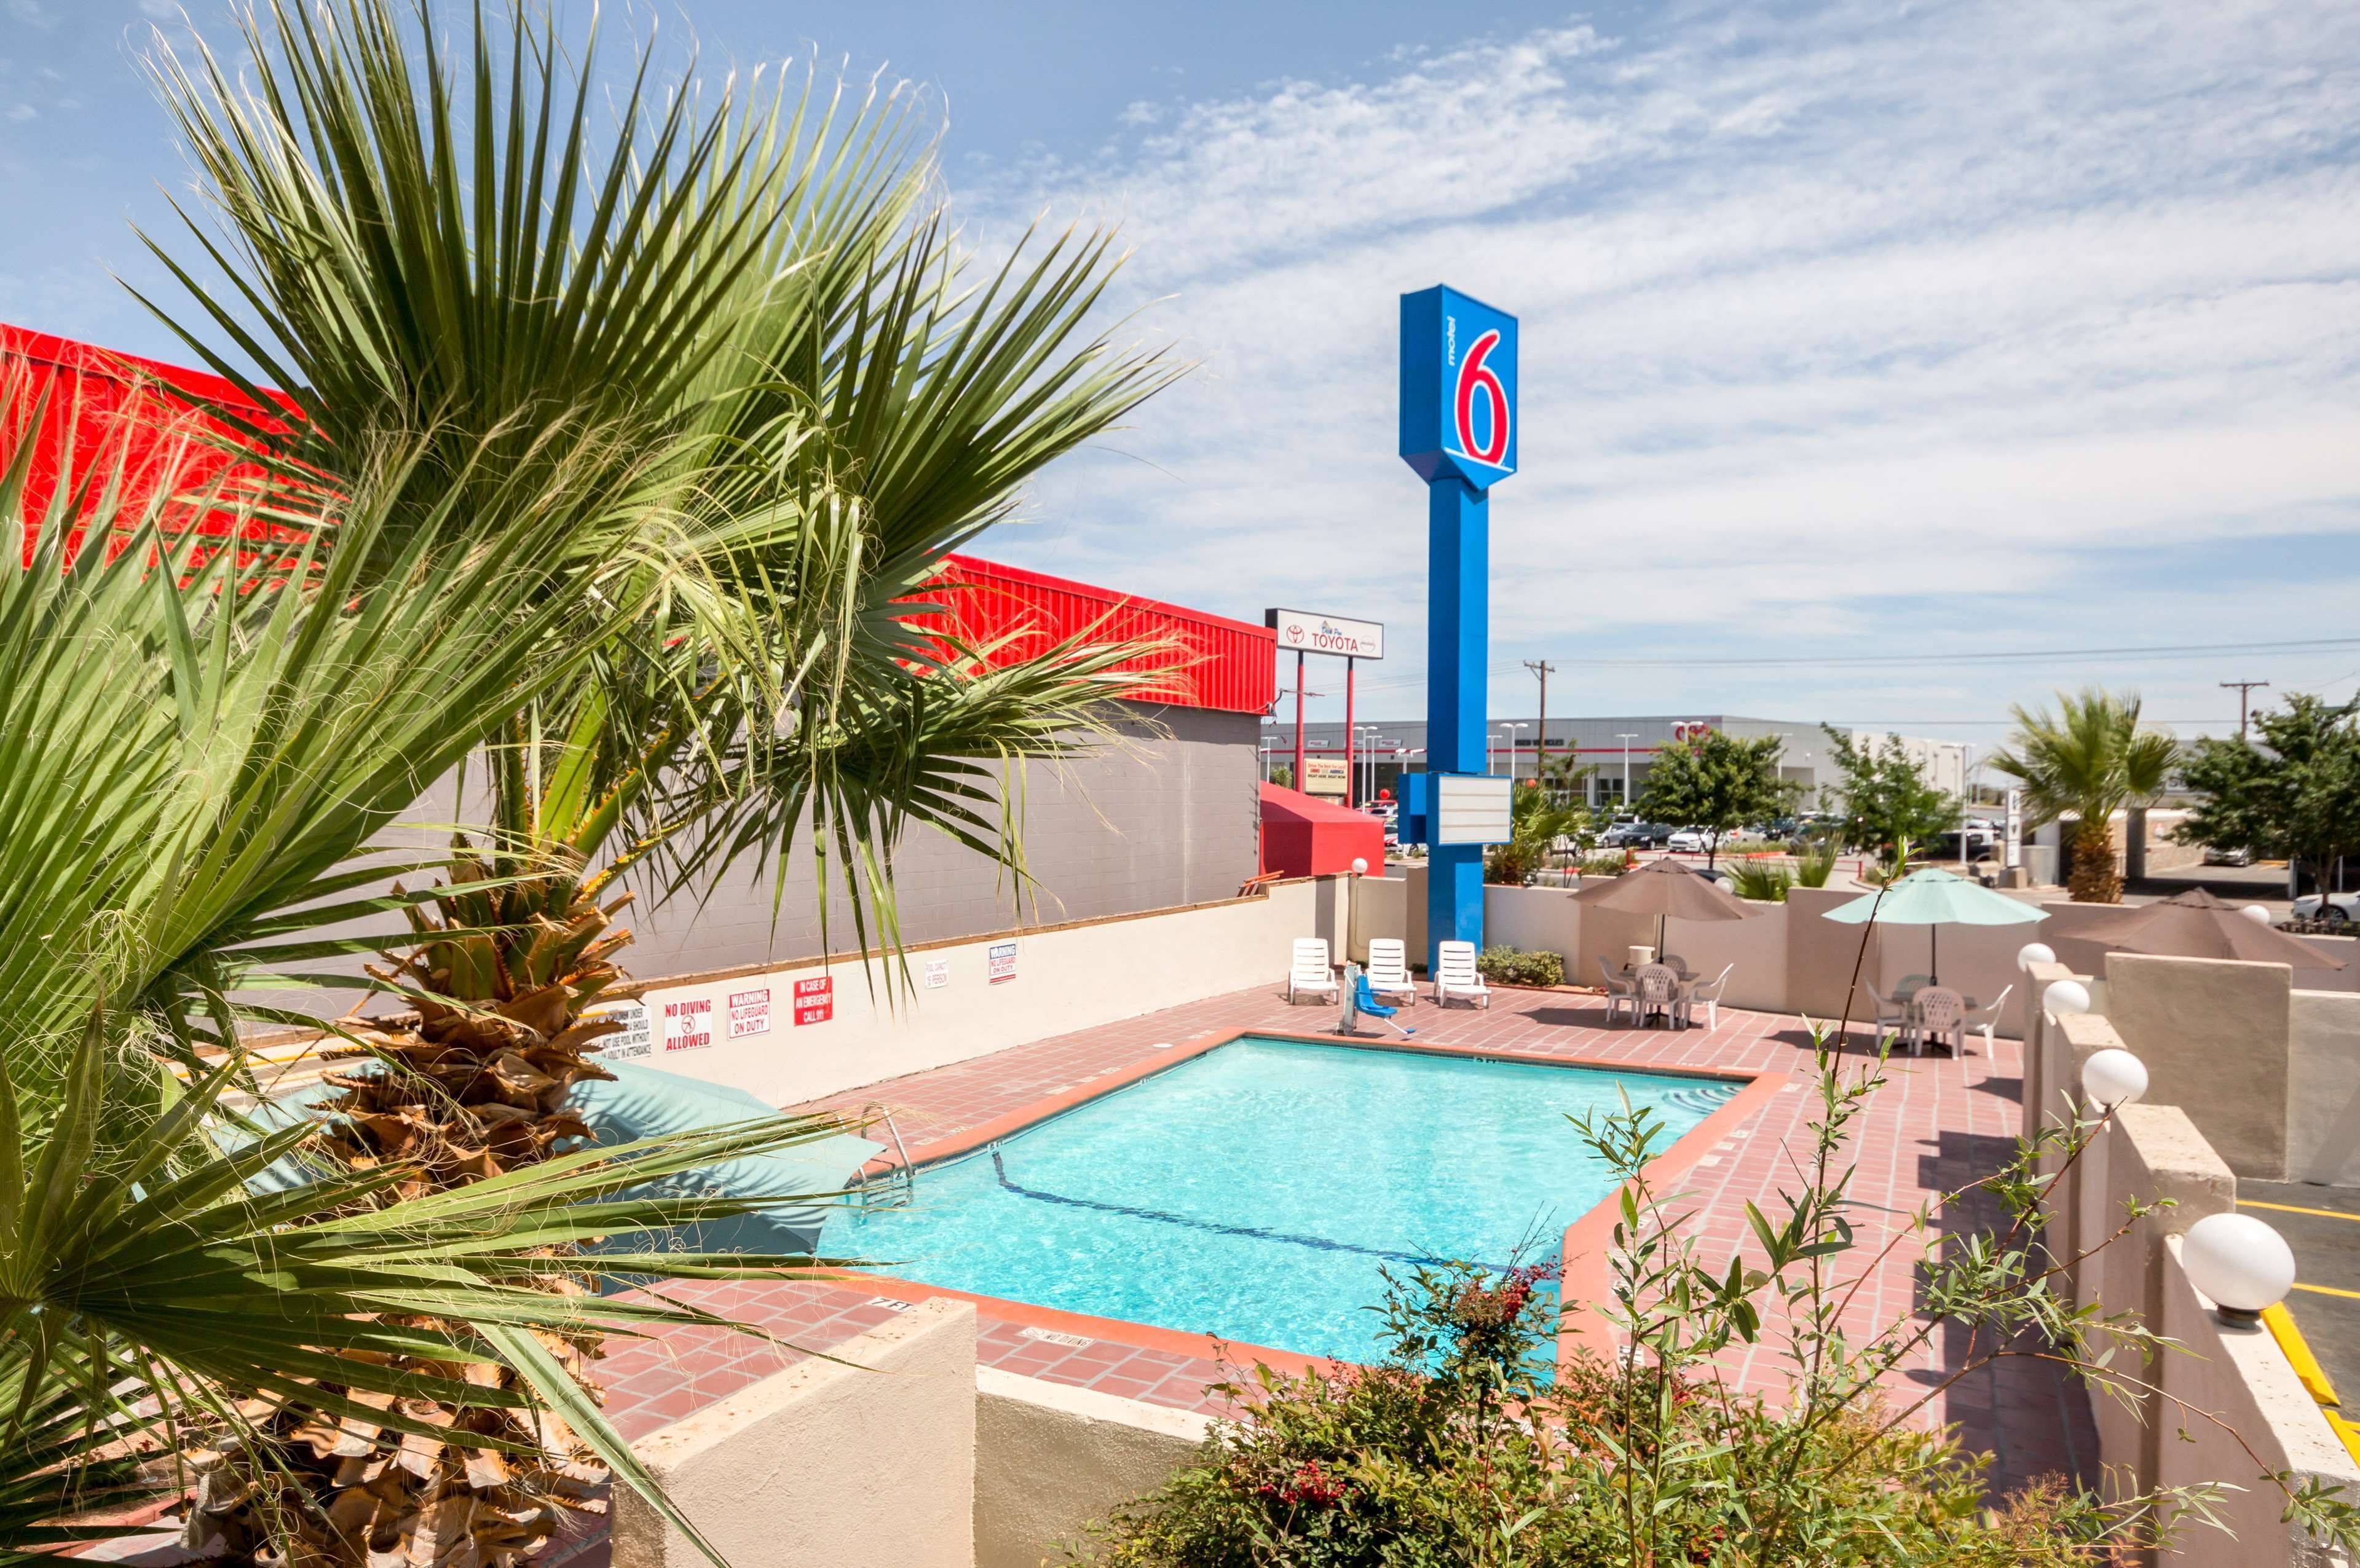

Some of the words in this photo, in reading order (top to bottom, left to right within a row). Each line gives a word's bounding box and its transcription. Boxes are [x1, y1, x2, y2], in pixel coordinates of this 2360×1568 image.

[1446, 315, 1456, 366] motel
[1454, 328, 1510, 467] 6
[1312, 633, 1358, 652] TOYOTA
[990, 945, 1015, 959] WARNING
[806, 980, 819, 991] CASE
[732, 990, 768, 1007] WARNING
[795, 996, 803, 1009] AN
[803, 993, 831, 1007] EMERGENCY
[665, 1003, 677, 1017] NO
[681, 999, 711, 1015] DIVING
[732, 1009, 739, 1021] NO
[740, 1004, 768, 1020] LIFEGUARD
[803, 1011, 816, 1022] CALL
[633, 1019, 649, 1031] SHOULD
[735, 1023, 744, 1034] ON
[747, 1018, 765, 1032] DUTY
[621, 1034, 631, 1046] POOL
[632, 1031, 650, 1044] WITHOUT
[666, 1032, 709, 1051] ALLOWED
[626, 1044, 652, 1057] ATTENDANCE
[889, 1301, 914, 1310] FT
